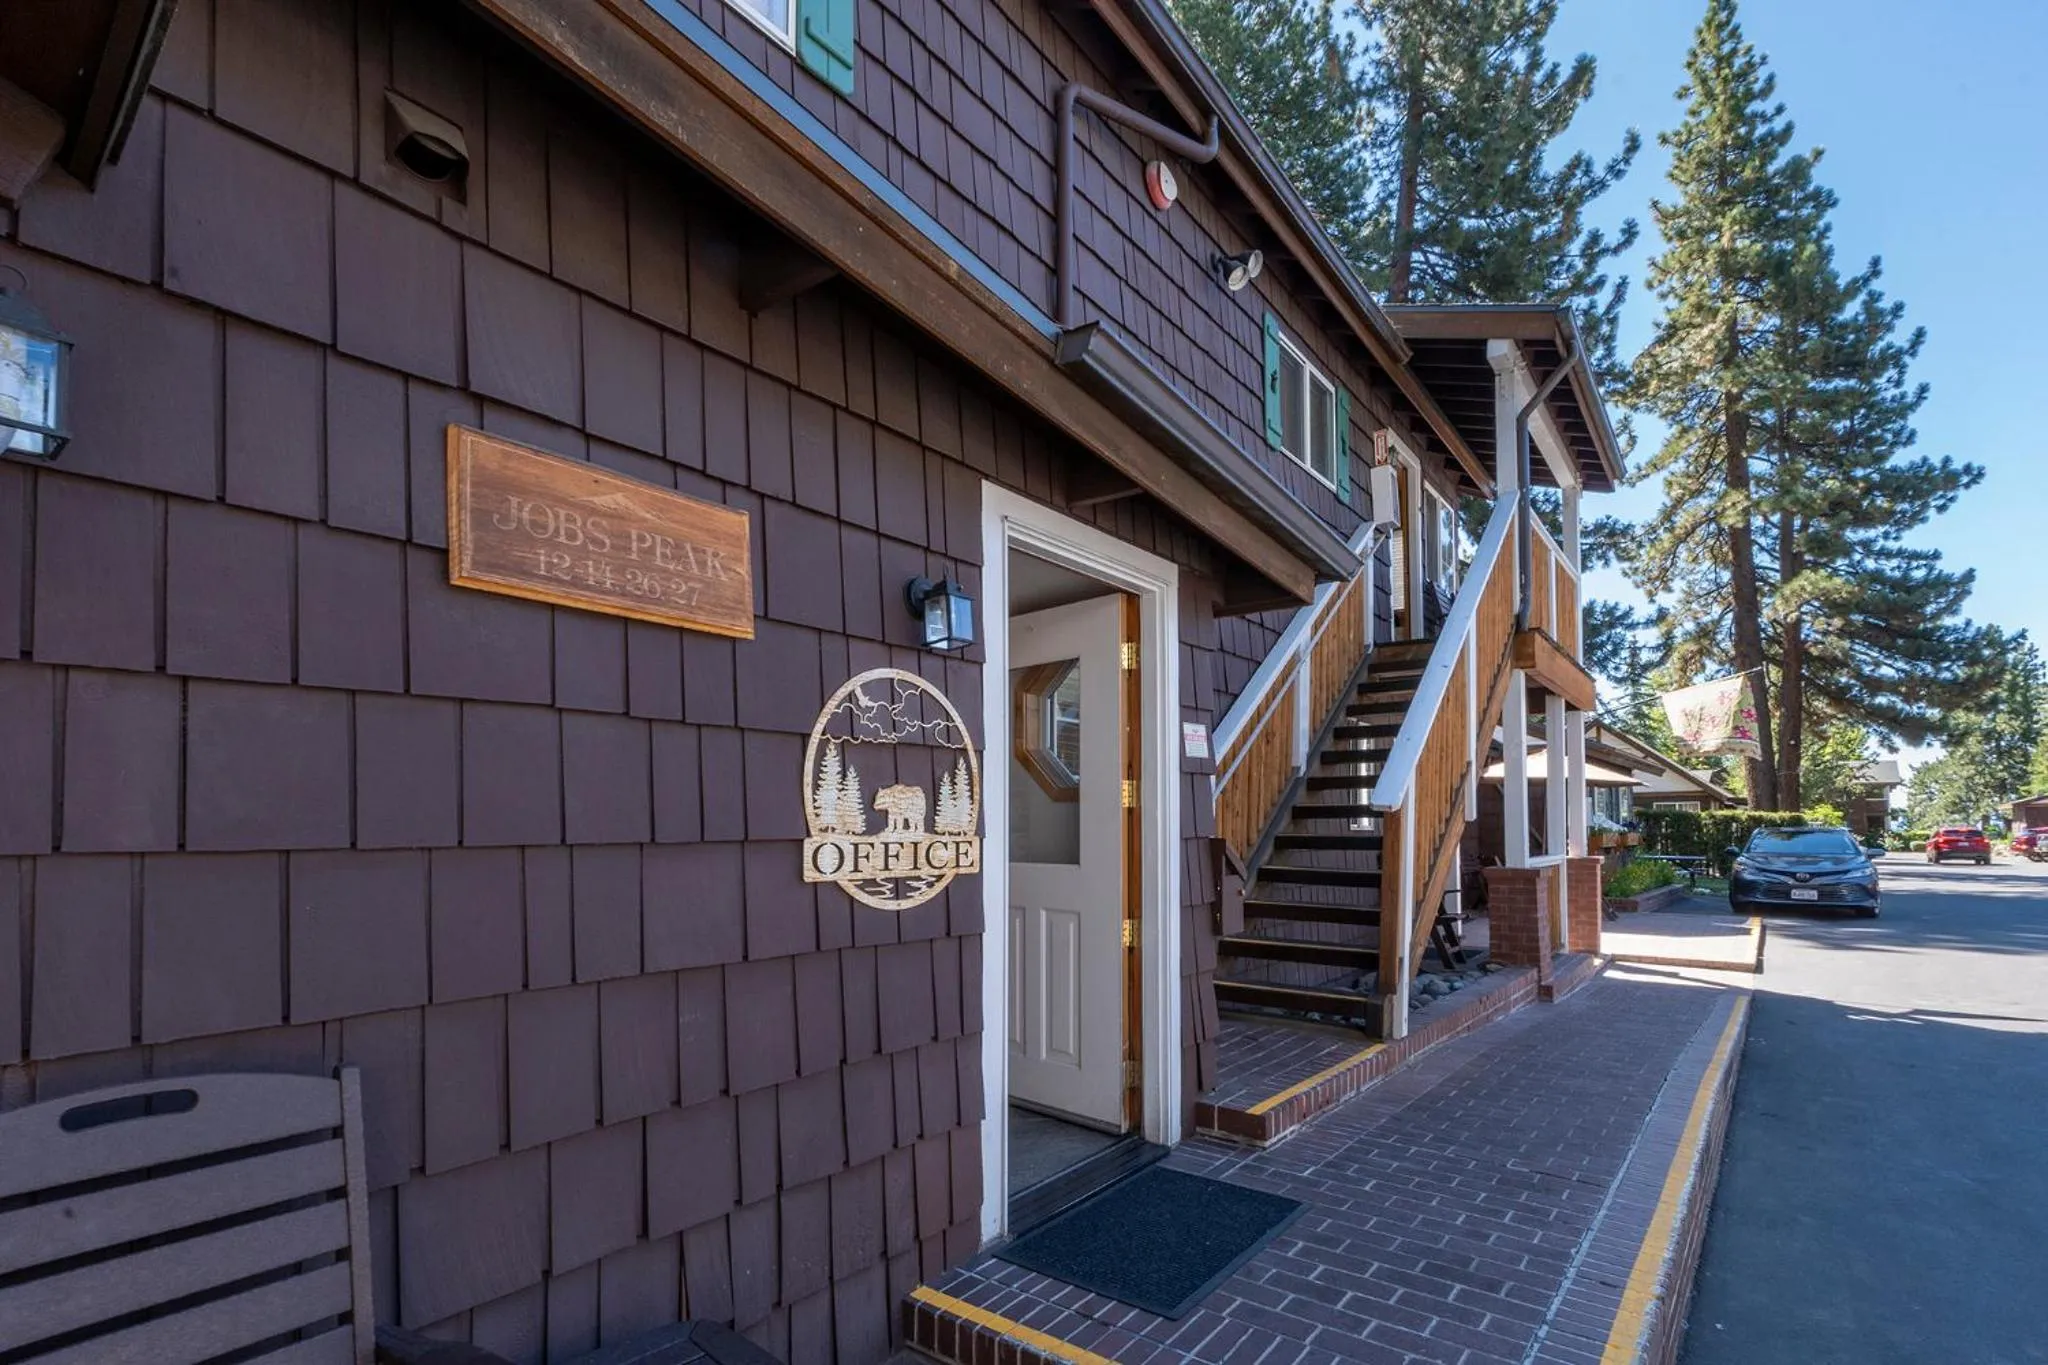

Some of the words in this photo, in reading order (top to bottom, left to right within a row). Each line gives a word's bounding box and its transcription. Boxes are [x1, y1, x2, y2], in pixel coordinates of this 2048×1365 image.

[492, 496, 611, 552] JOBS
[629, 530, 729, 581] PEAK
[811, 840, 975, 876] OFFICE
